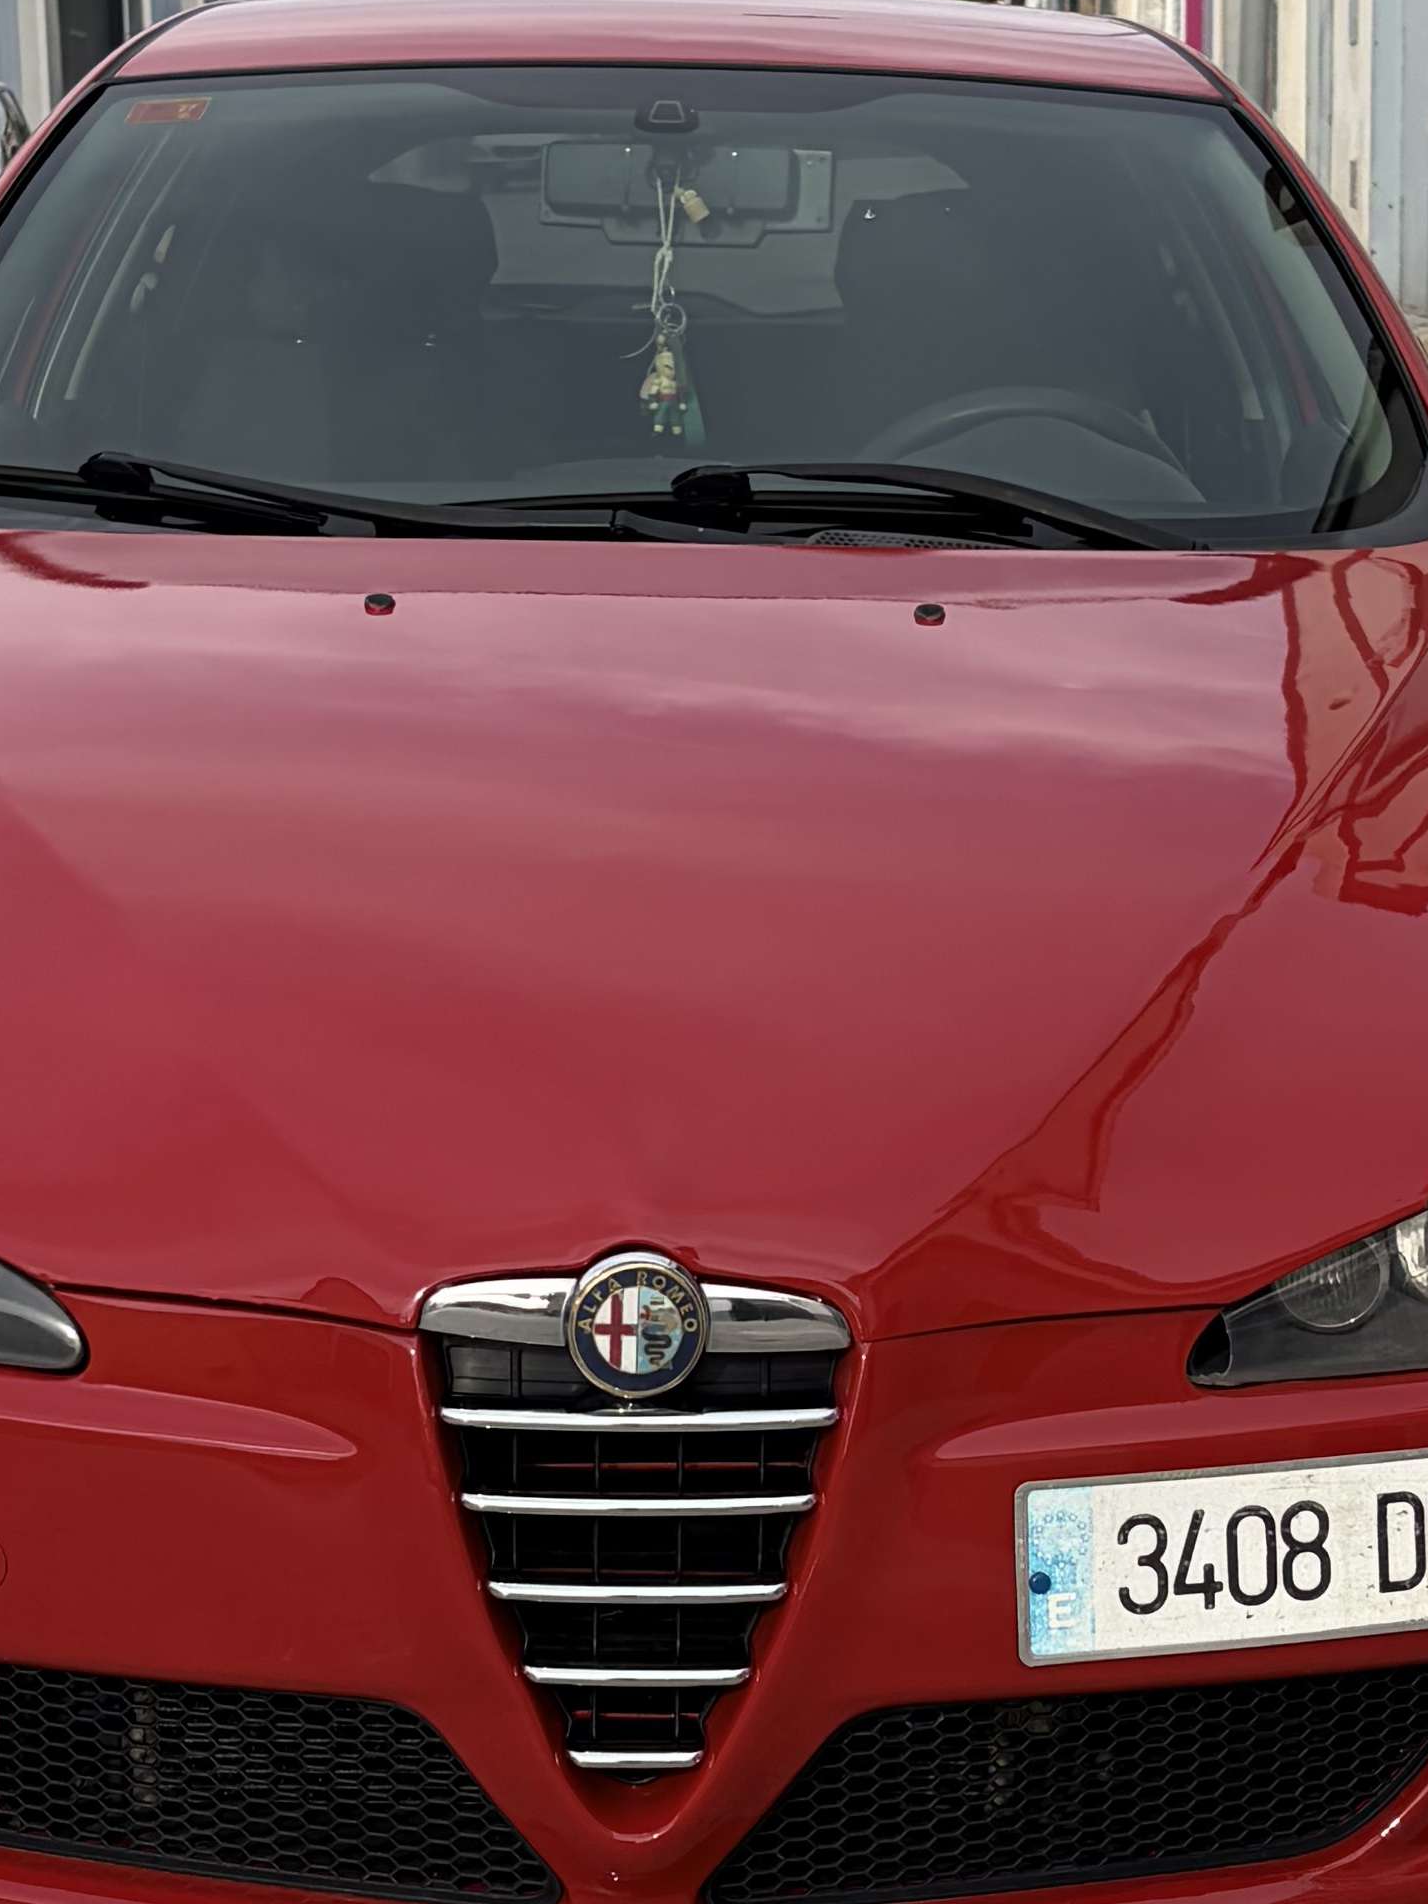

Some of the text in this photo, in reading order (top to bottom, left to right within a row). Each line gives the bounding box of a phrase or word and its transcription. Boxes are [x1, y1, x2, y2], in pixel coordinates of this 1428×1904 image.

[578, 1270, 698, 1334] ALFA ROMEO
[1117, 1499, 1332, 1615] 3408
[1047, 1592, 1077, 1628] E
